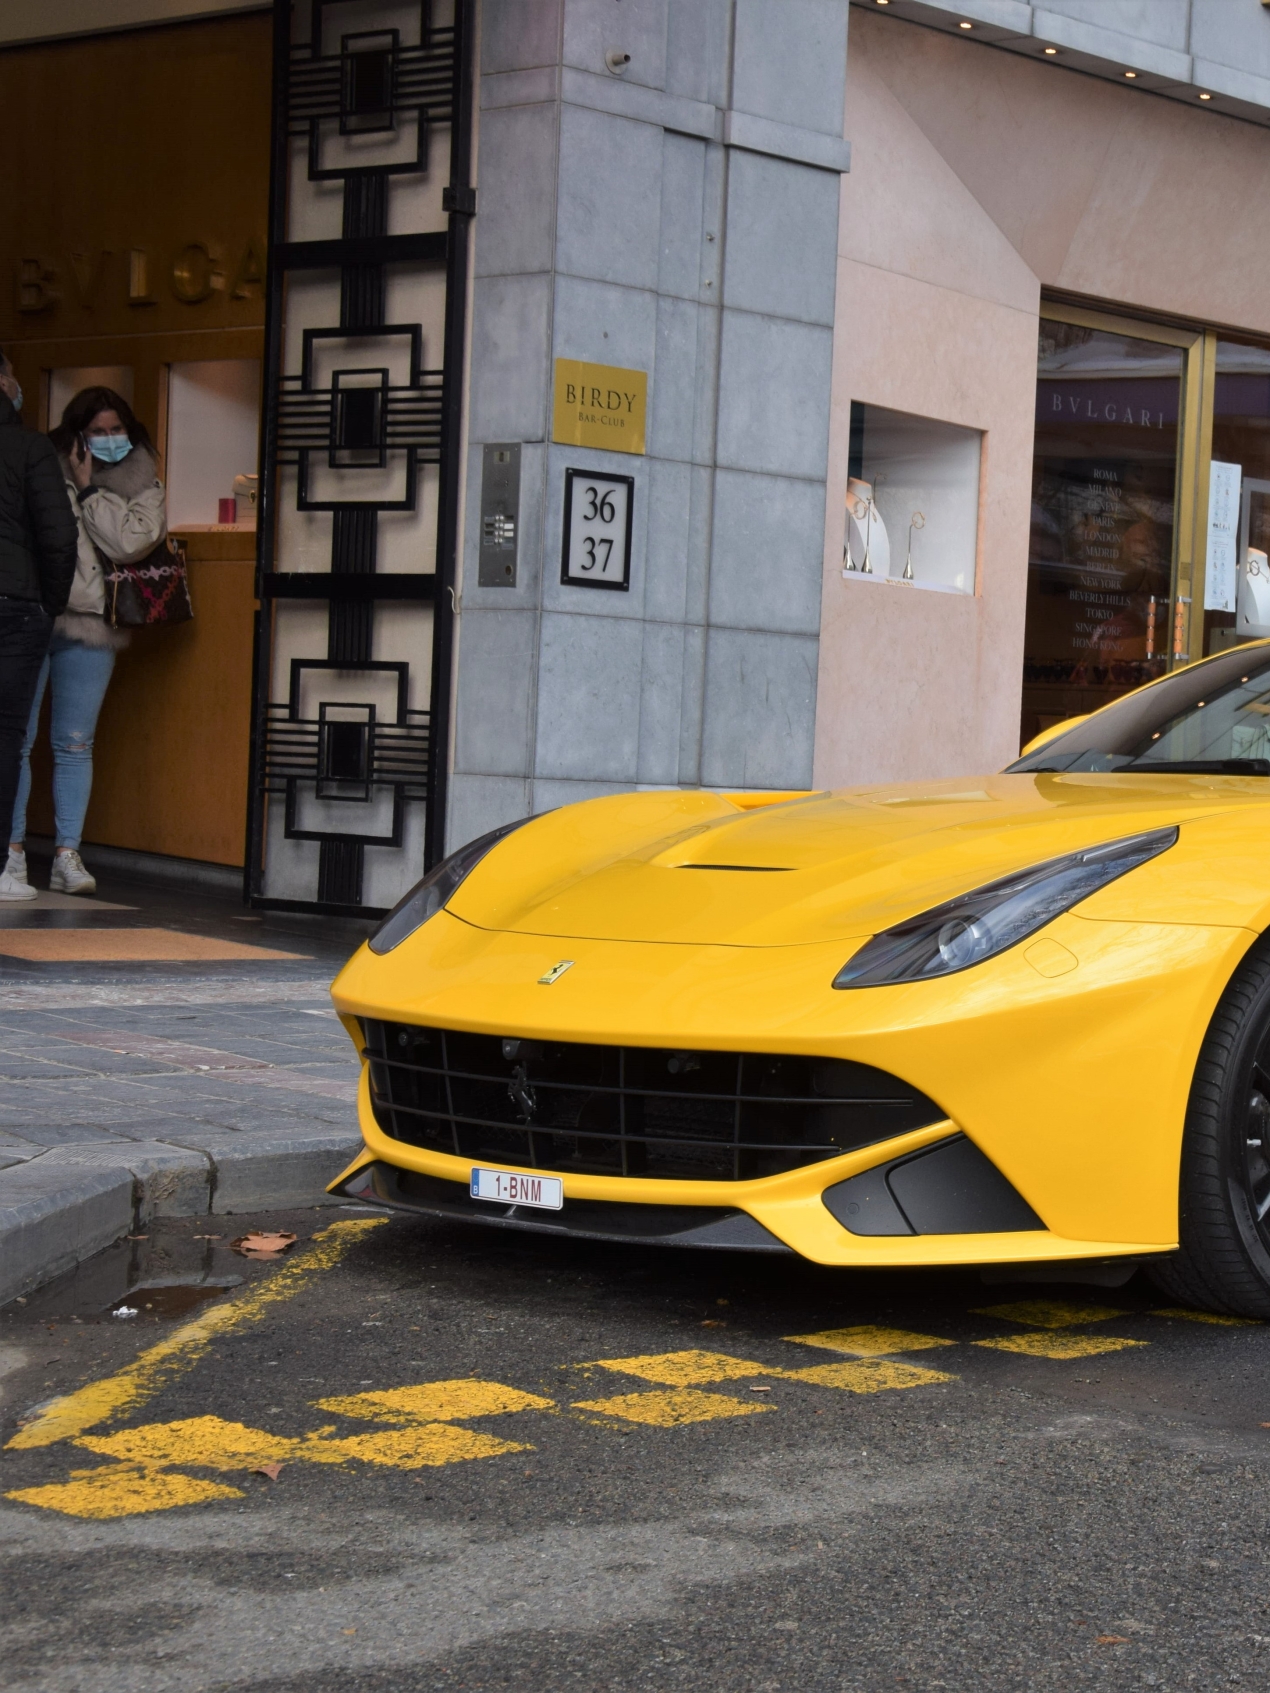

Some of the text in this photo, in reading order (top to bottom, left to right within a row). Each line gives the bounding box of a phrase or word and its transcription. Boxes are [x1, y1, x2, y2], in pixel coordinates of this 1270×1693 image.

[566, 383, 637, 413] BIRDY
[1052, 393, 1163, 429] BVLGARI
[1093, 468, 1118, 481] ROMA
[1088, 483, 1122, 498] MILANO
[583, 486, 616, 524] 36
[1093, 515, 1115, 528] PARIS
[1084, 530, 1121, 543] LONDON
[581, 536, 614, 573] 37
[1086, 545, 1119, 559] MADRID
[1081, 576, 1122, 590] NEW YORK
[1069, 589, 1131, 606] BEVERLY HILLS
[1085, 607, 1114, 620] TOKYO
[1075, 621, 1122, 637] SINGAPORE
[1072, 637, 1124, 652] HONG KONG
[473, 1185, 478, 1194] B
[496, 1175, 541, 1202] 1-BNM
